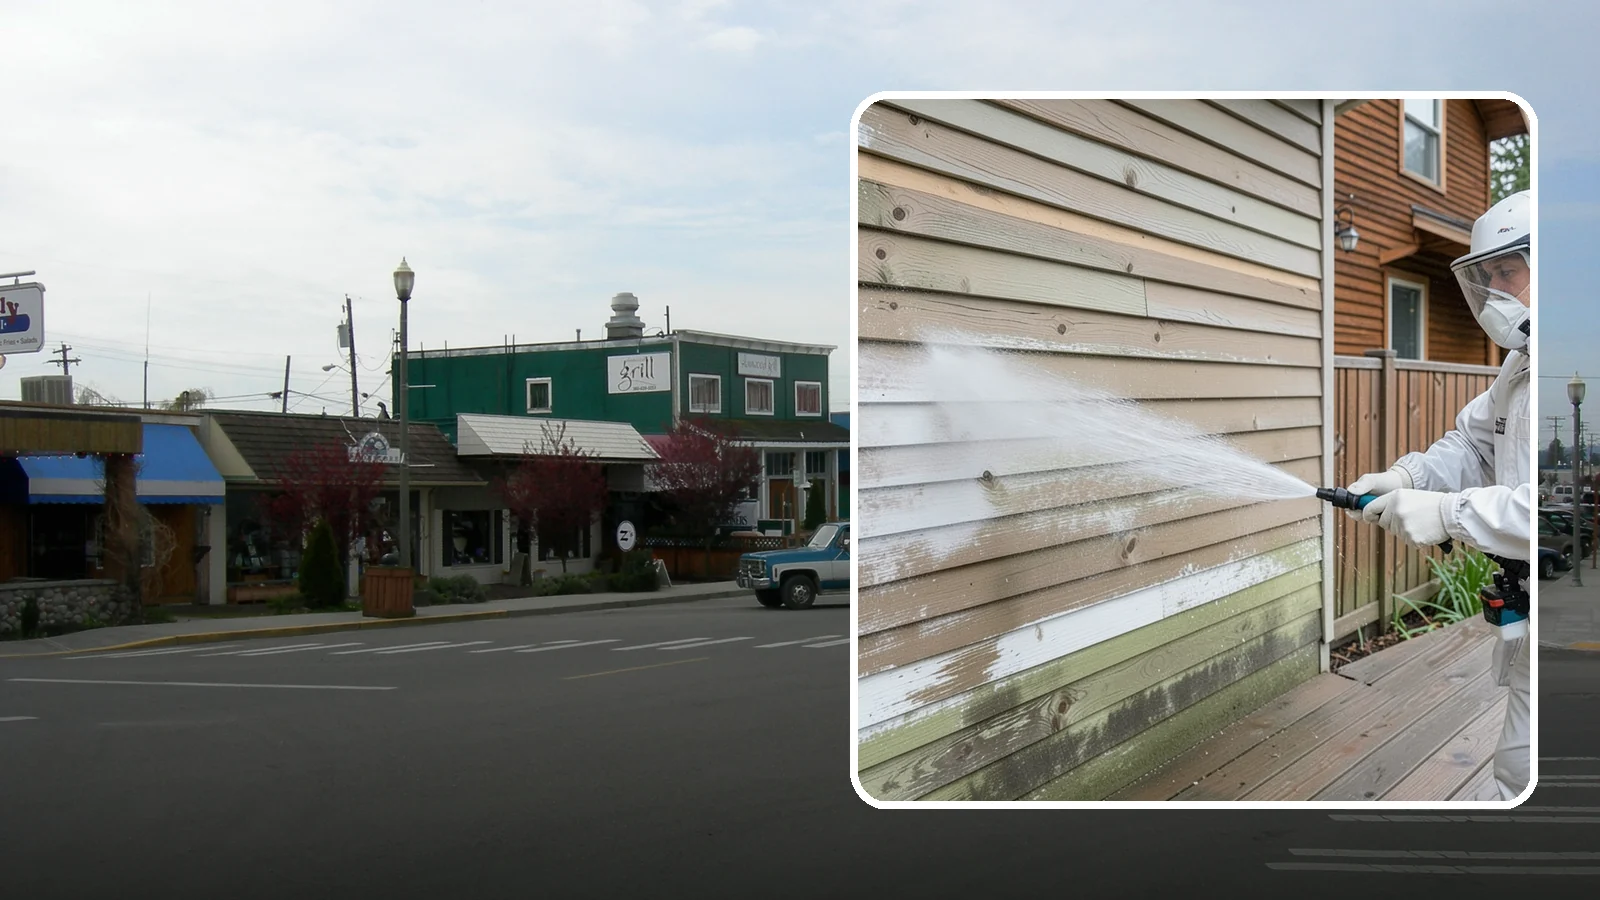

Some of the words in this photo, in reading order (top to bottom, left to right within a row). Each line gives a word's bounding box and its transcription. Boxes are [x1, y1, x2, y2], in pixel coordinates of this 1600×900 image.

[3, 338, 16, 346] Fries
[20, 336, 38, 345] Salads
[618, 356, 655, 391] grill
